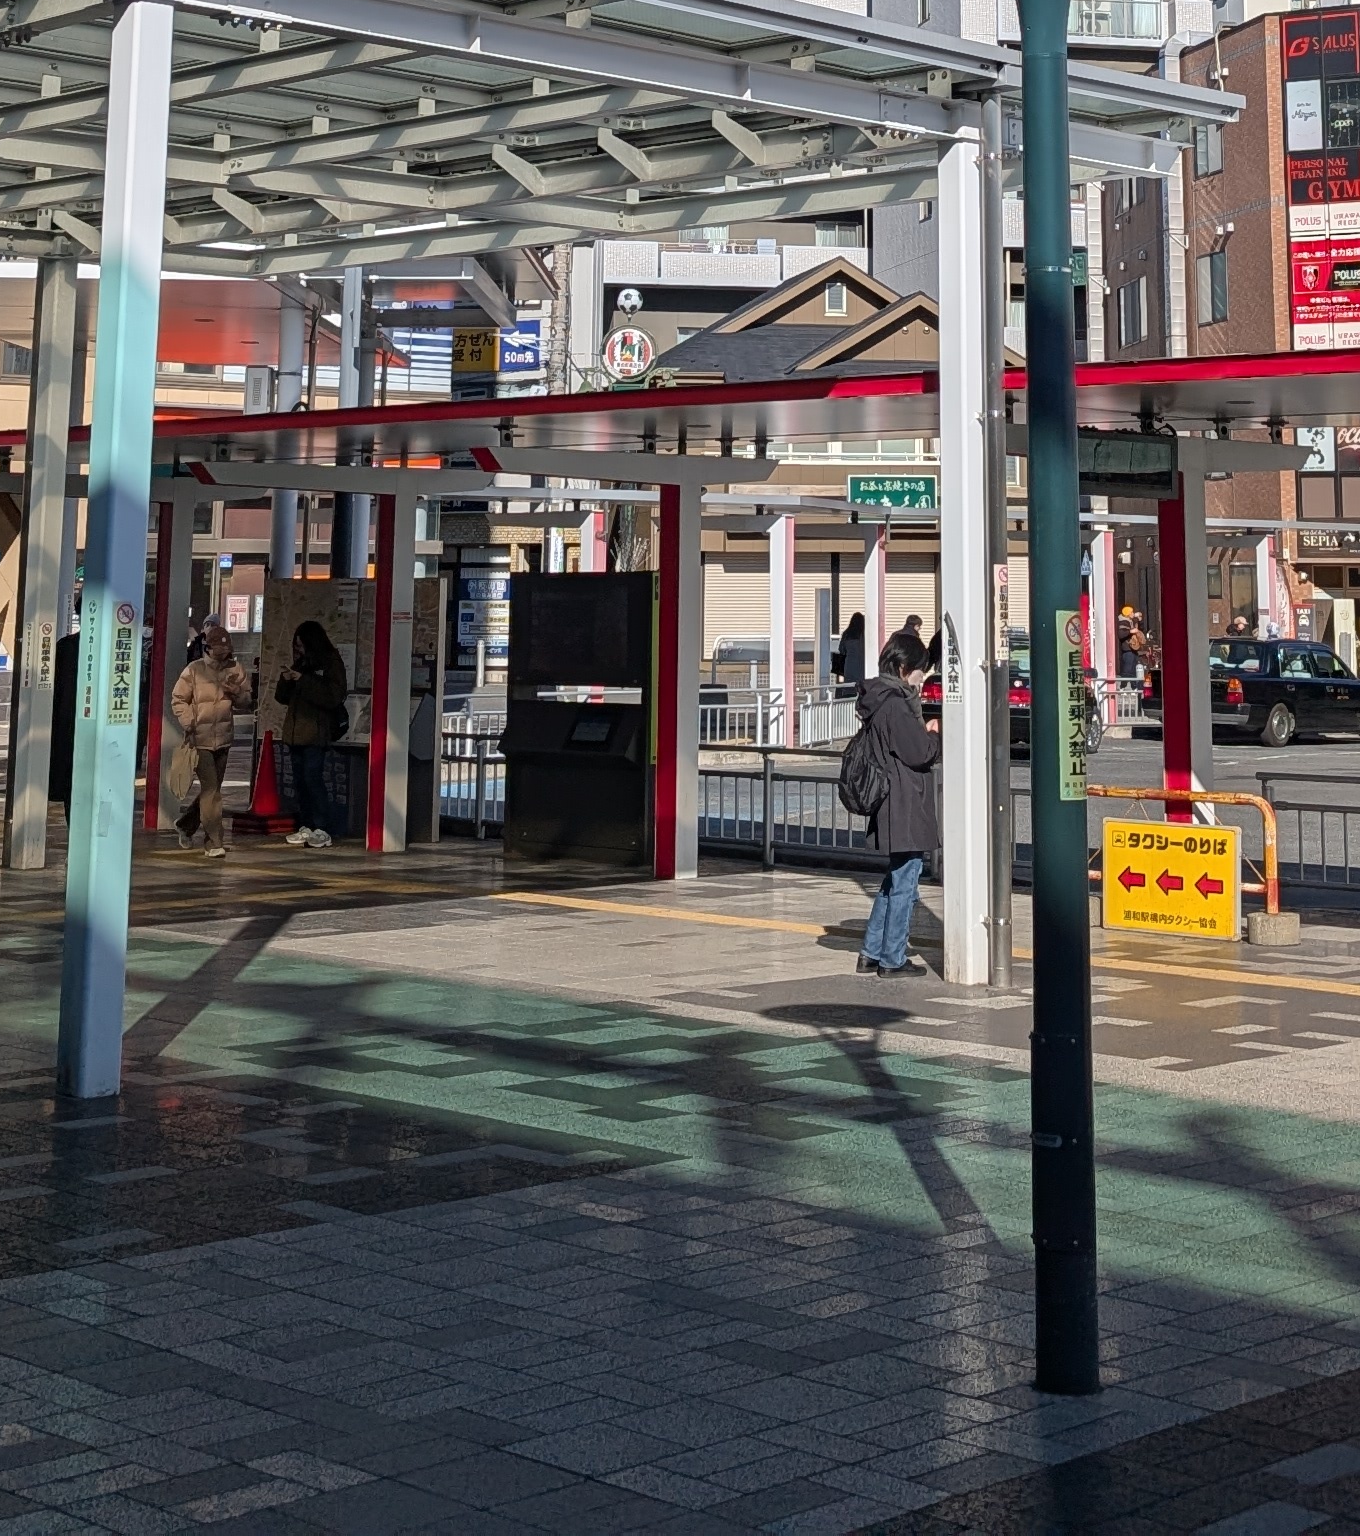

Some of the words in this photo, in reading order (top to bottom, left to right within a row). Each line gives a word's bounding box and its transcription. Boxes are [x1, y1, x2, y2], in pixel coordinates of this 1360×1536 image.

[1312, 34, 1356, 50] SALUS
[1290, 156, 1349, 170] PERSONAL
[1290, 168, 1346, 180] TRAINING
[1294, 217, 1322, 227] POLUS
[1298, 335, 1326, 345] POLUS
[1303, 535, 1339, 547] SEPIA
[87, 617, 95, 681] サッカーのまち
[112, 627, 132, 711] 自転車乗入禁止
[1067, 649, 1086, 776] 自転車乗入禁止
[1128, 832, 1228, 855] タクシーのりば
